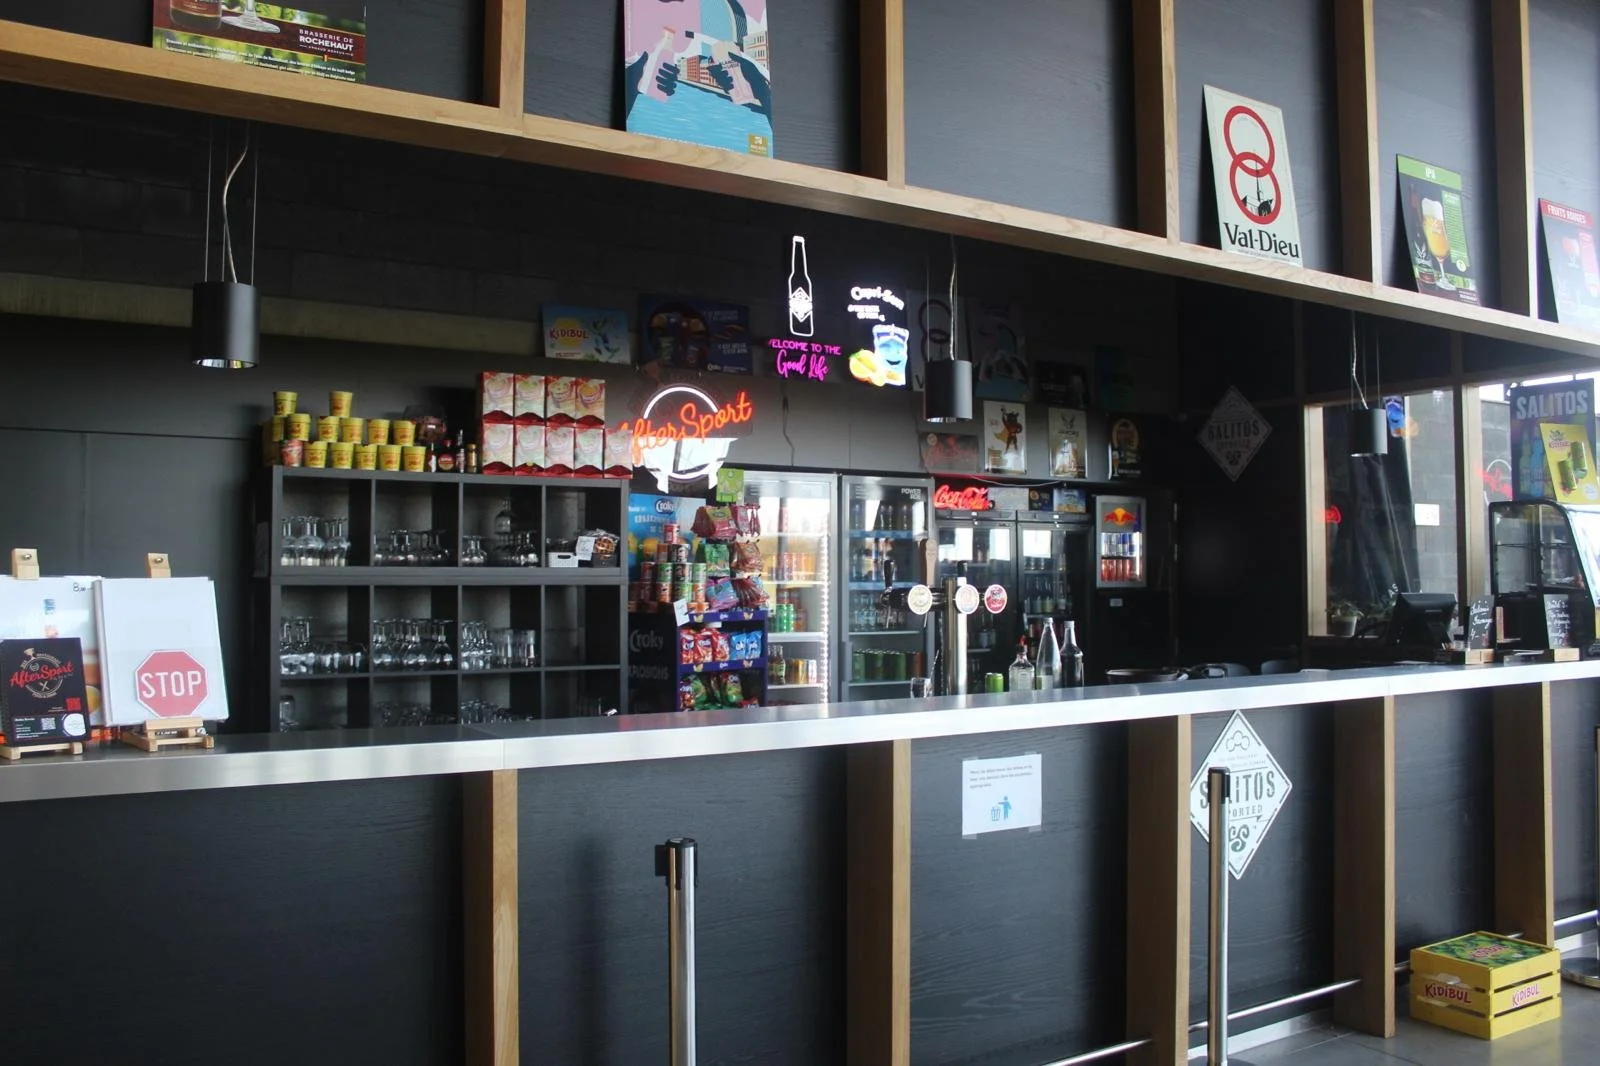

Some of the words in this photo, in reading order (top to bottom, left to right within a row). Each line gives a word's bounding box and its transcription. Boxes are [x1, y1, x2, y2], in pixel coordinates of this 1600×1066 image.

[298, 28, 341, 42] BRASSERIE
[342, 36, 354, 44] DE
[298, 35, 355, 52] ROCHEHAUT
[1223, 222, 1300, 259] Val-Dieu
[811, 343, 823, 352] TO
[824, 345, 841, 355] THE
[777, 349, 807, 378] Good
[1516, 389, 1589, 420] SALITOS
[629, 629, 664, 653] Croky
[140, 670, 203, 699] STOP
[1199, 770, 1276, 810] SITOS
[1424, 982, 1472, 1004] KIDIBUL
[1512, 983, 1541, 1008] KIDIBUL
